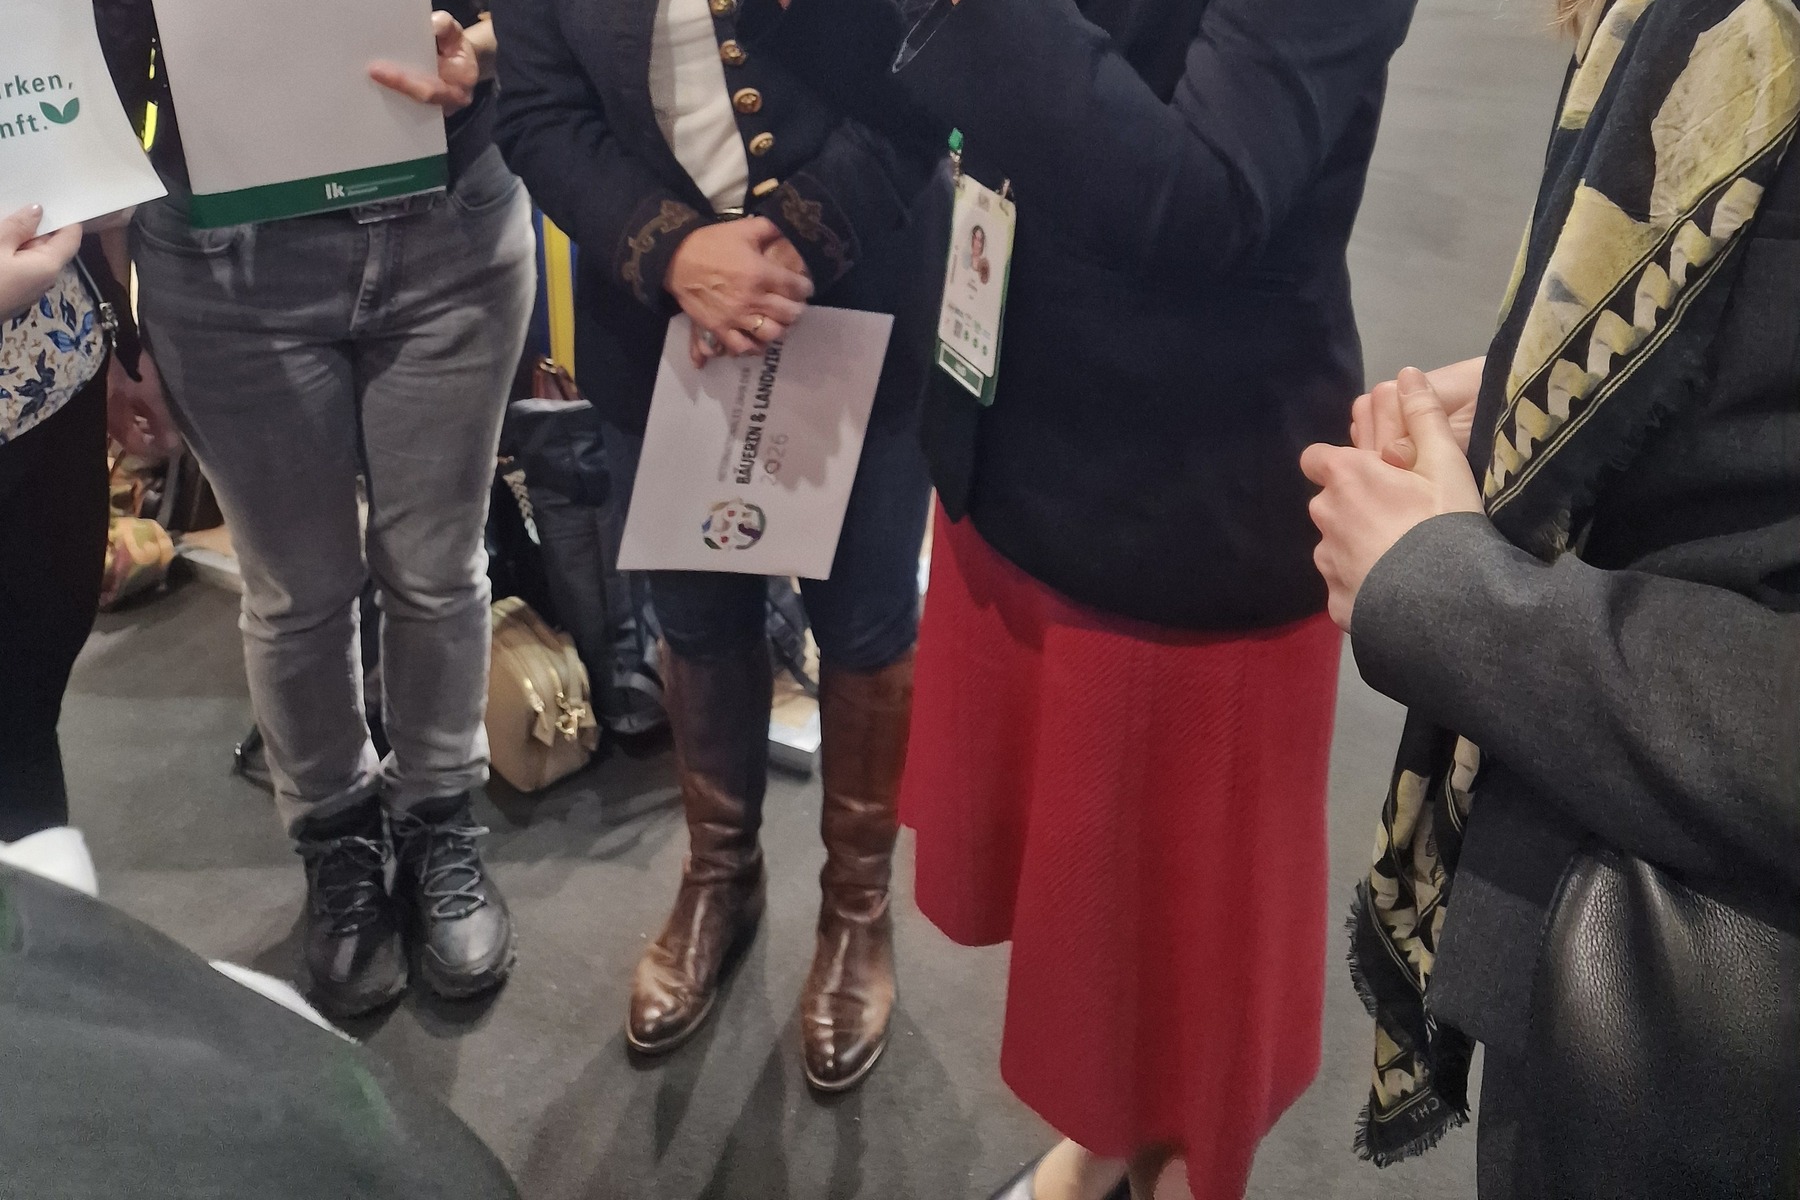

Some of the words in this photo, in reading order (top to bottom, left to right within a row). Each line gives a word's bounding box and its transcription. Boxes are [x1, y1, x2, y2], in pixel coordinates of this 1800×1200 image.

[0, 74, 73, 99] rken,
[733, 425, 762, 485] BÄUERIN
[750, 413, 767, 423] &
[760, 434, 789, 486] 2026
